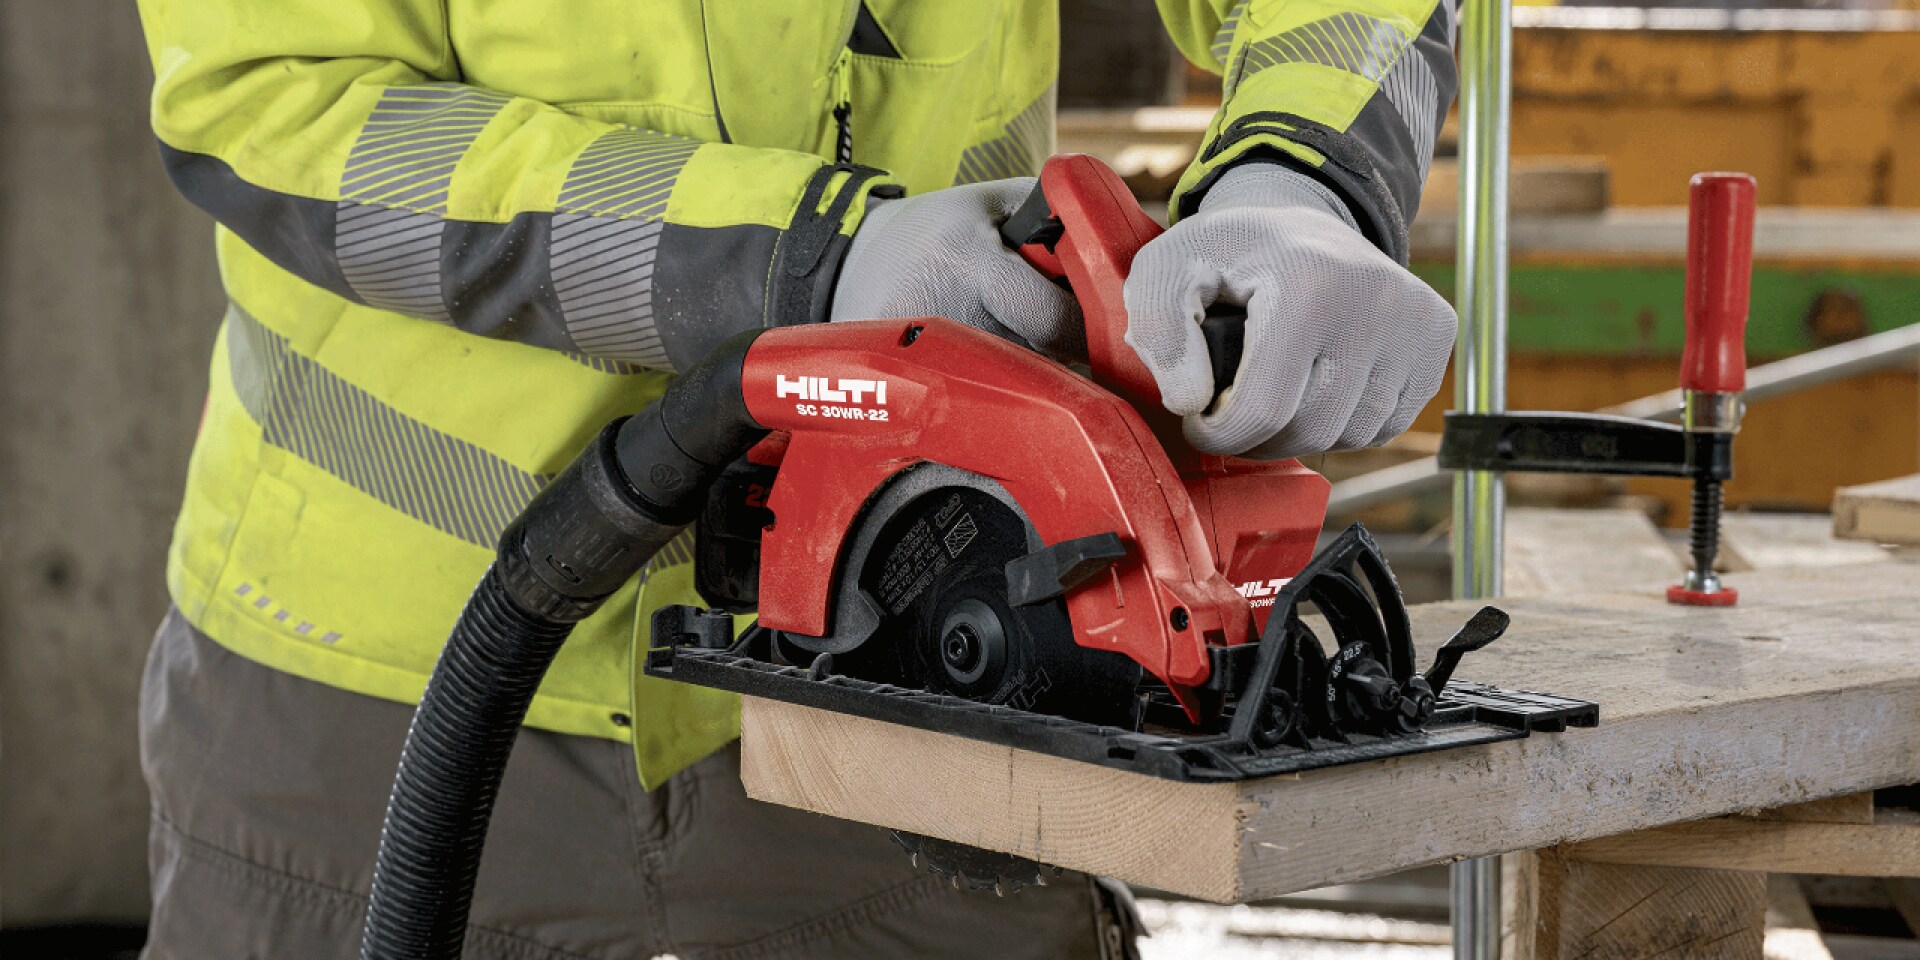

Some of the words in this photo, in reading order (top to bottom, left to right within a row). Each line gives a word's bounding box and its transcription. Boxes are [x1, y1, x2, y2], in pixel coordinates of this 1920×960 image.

[776, 374, 887, 405] HILTI
[796, 403, 818, 416] SC
[820, 405, 889, 421] 30WR-22
